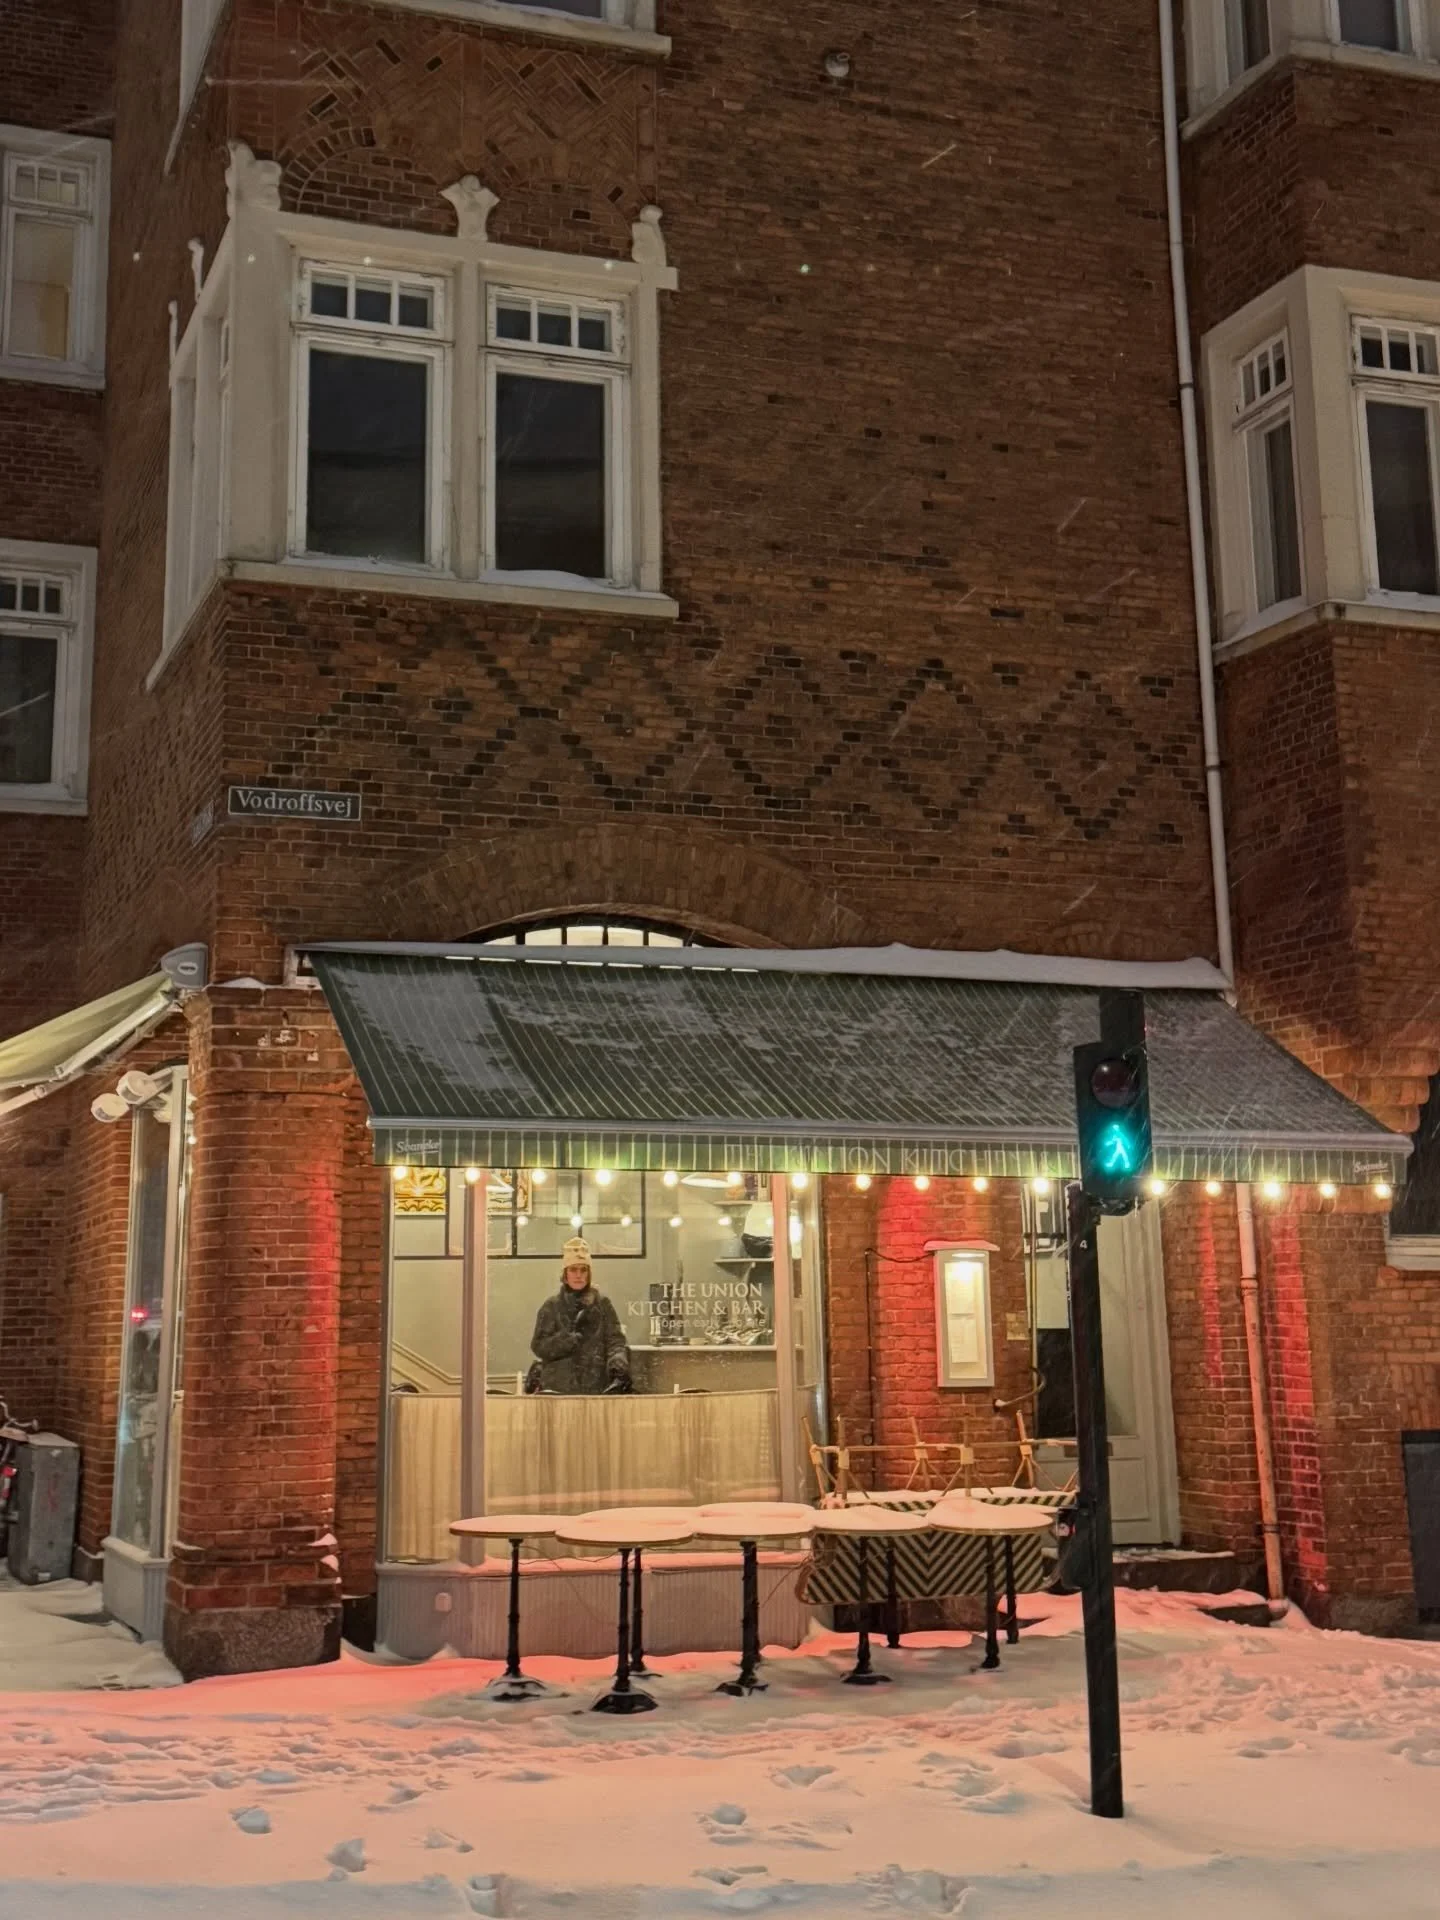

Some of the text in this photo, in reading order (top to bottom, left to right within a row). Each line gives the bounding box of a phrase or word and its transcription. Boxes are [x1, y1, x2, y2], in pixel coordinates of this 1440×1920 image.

[236, 790, 352, 818] Vodroffsvej
[660, 1282, 763, 1298] THE UNION
[627, 1300, 766, 1316] KITCHEN & BAR
